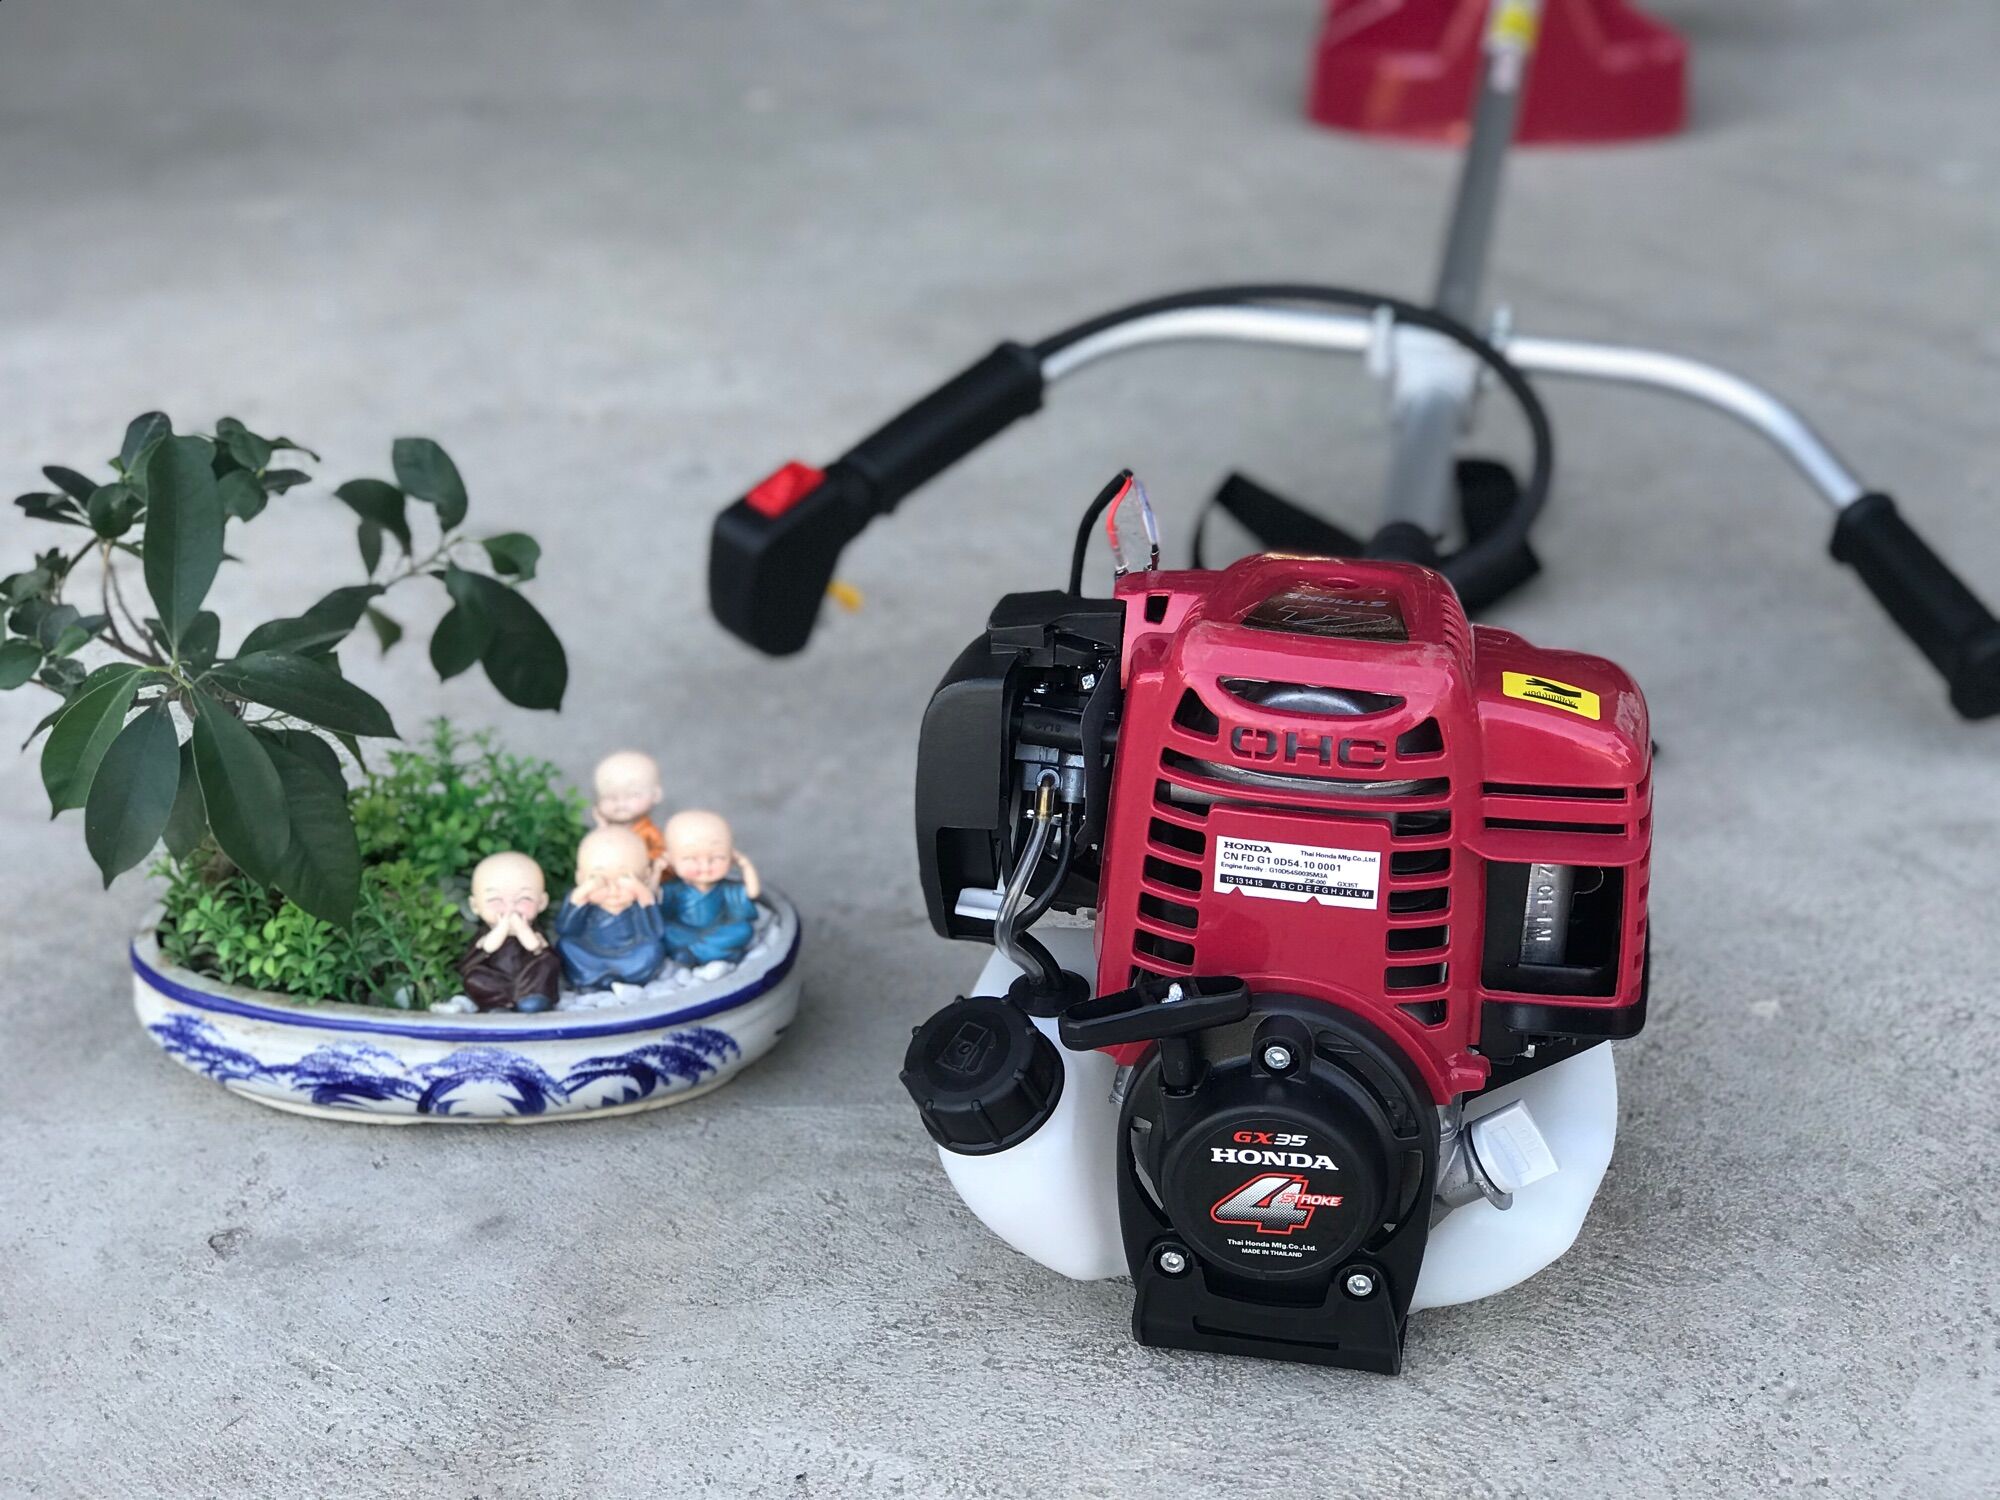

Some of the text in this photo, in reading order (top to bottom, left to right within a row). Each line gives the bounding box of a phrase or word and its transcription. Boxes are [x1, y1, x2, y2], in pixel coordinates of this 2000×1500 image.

[1231, 725, 1388, 768] OHC
[1224, 841, 1272, 853] HONDA
[1221, 862, 1243, 870] Engine
[1243, 865, 1264, 873] family
[1223, 851, 1239, 861] CN
[1241, 853, 1255, 863] FD
[1257, 855, 1271, 864] G1
[1317, 862, 1341, 872] 0001
[1235, 877, 1244, 885] 13
[1233, 1131, 1308, 1147] GX35
[1210, 1147, 1340, 1171] HONDA
[1210, 1172, 1345, 1235] 4 STROKE
[1227, 1238, 1244, 1246] Thai
[1241, 1247, 1260, 1255] MADE
[1270, 1250, 1303, 1258] THAILAND
